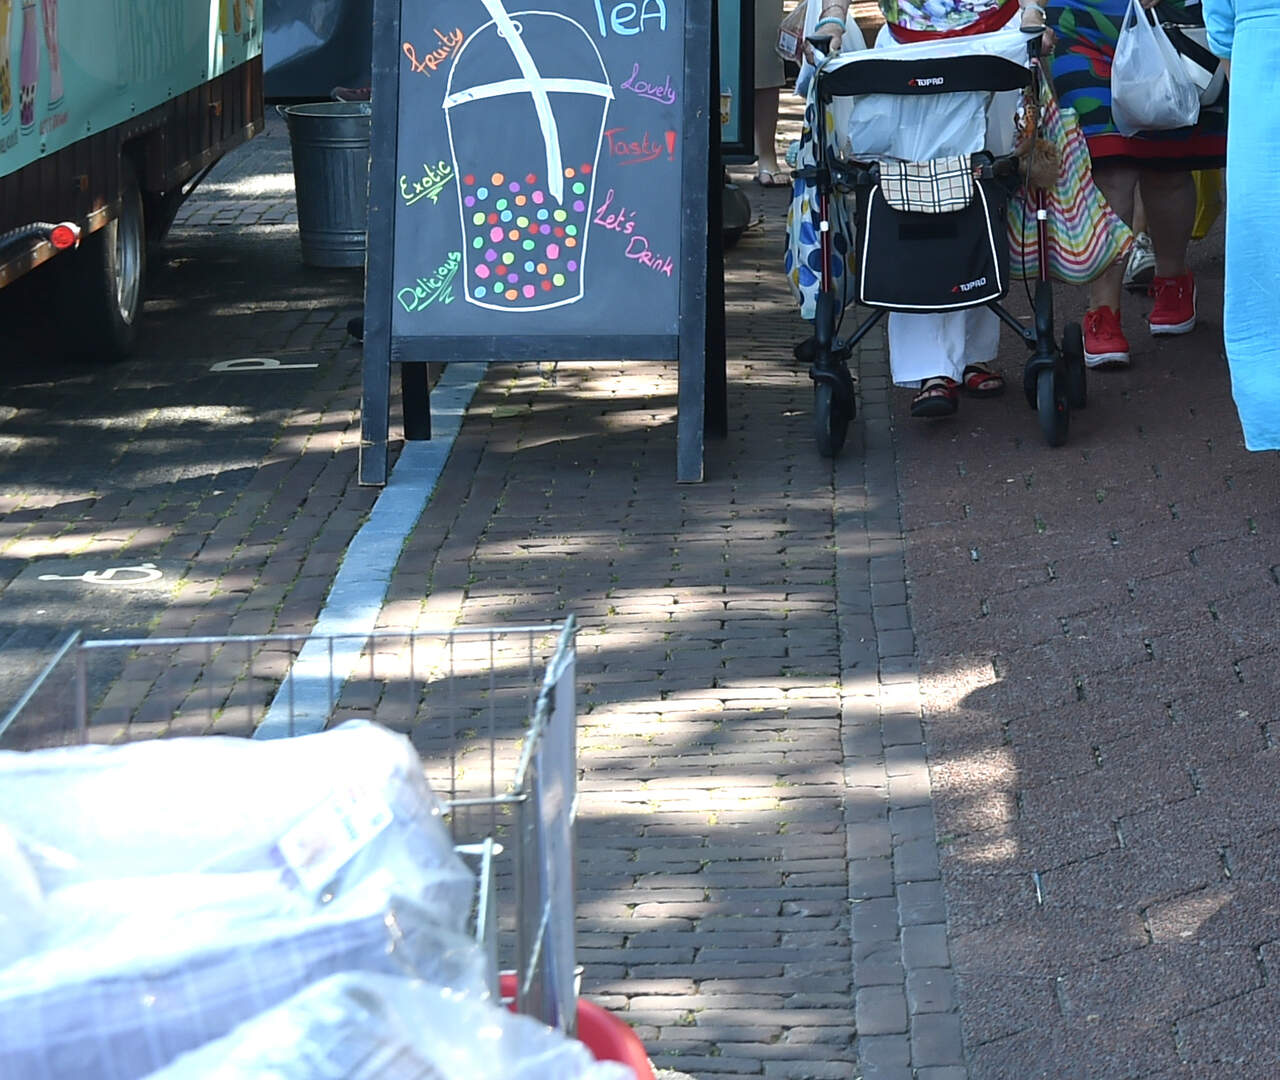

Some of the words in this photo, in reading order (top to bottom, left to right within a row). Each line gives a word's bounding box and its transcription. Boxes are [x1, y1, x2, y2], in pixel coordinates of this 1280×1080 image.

[620, 63, 677, 104] Lovely
[916, 77, 944, 87] TOPRO
[400, 160, 452, 200] Exotic
[594, 189, 636, 234] Let's
[397, 251, 462, 312] Delicious
[960, 277, 986, 292] TOPRO
